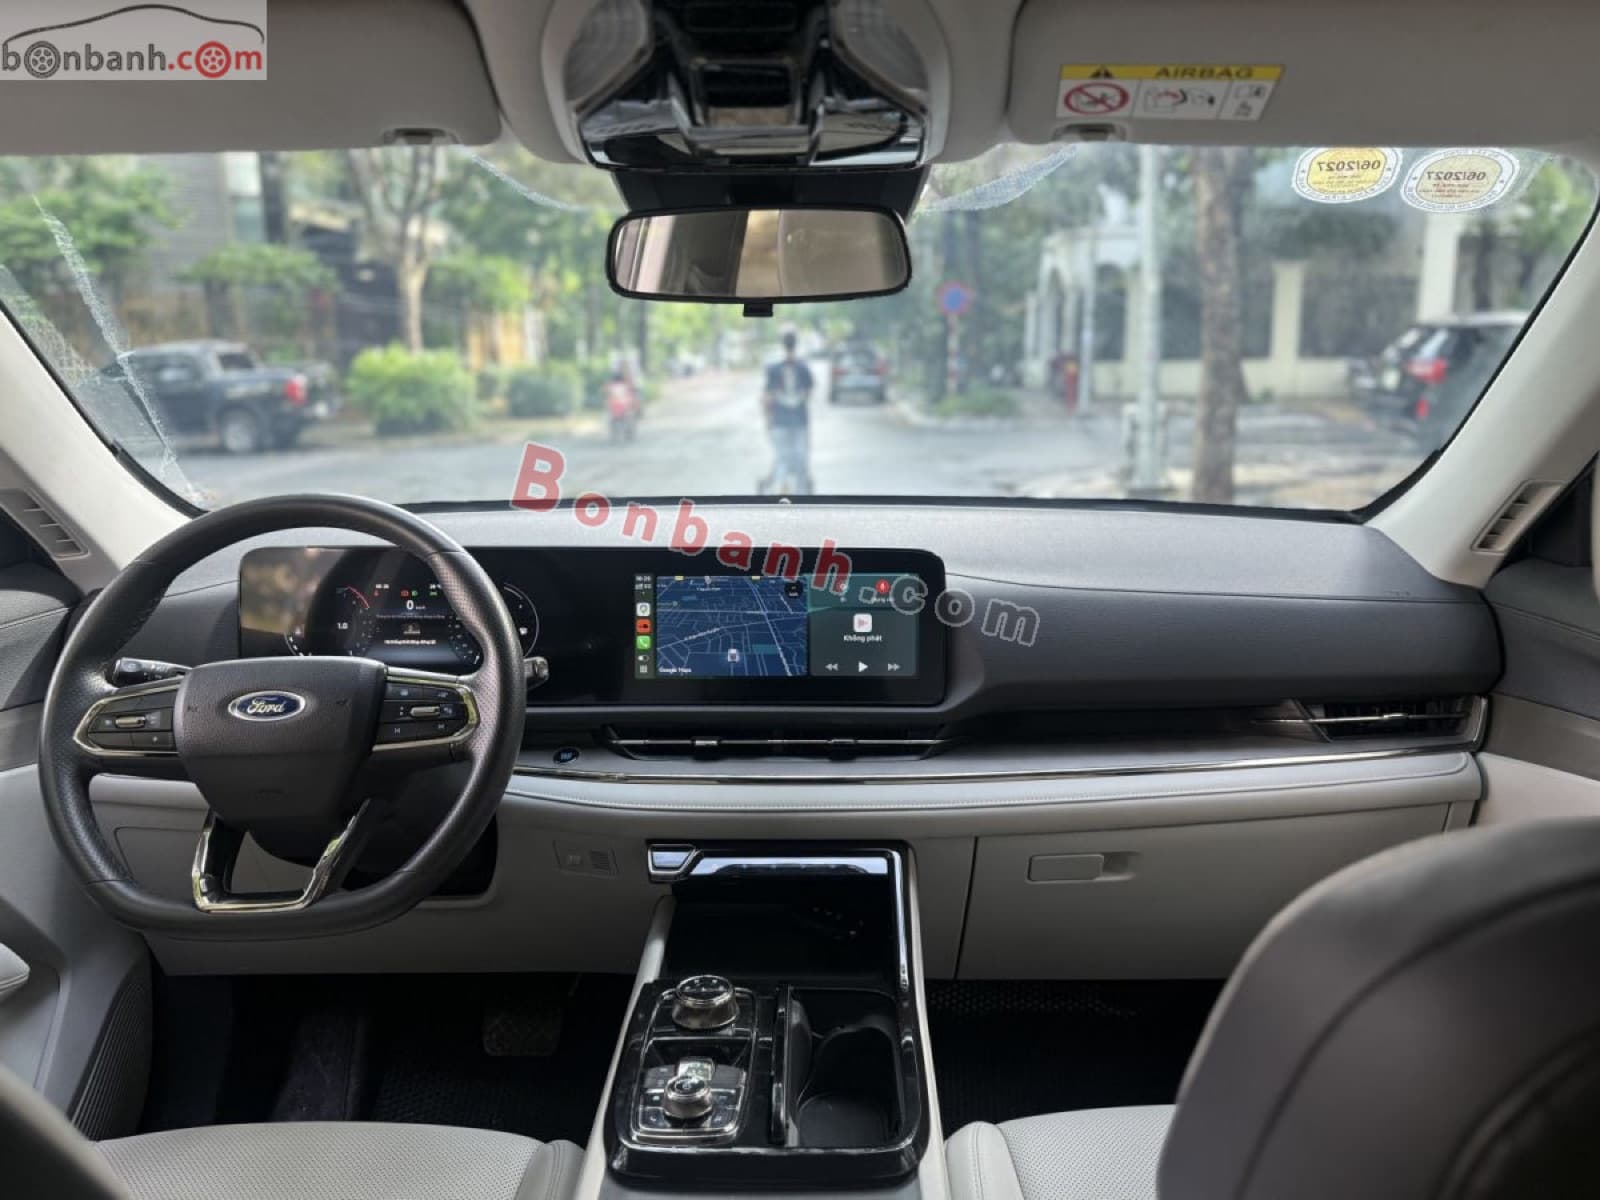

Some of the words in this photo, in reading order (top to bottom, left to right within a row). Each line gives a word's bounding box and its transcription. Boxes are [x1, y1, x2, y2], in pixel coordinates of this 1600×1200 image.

[1154, 67, 1254, 79] AIRBAG
[659, 666, 677, 674] Google
[246, 699, 285, 713] Ford
